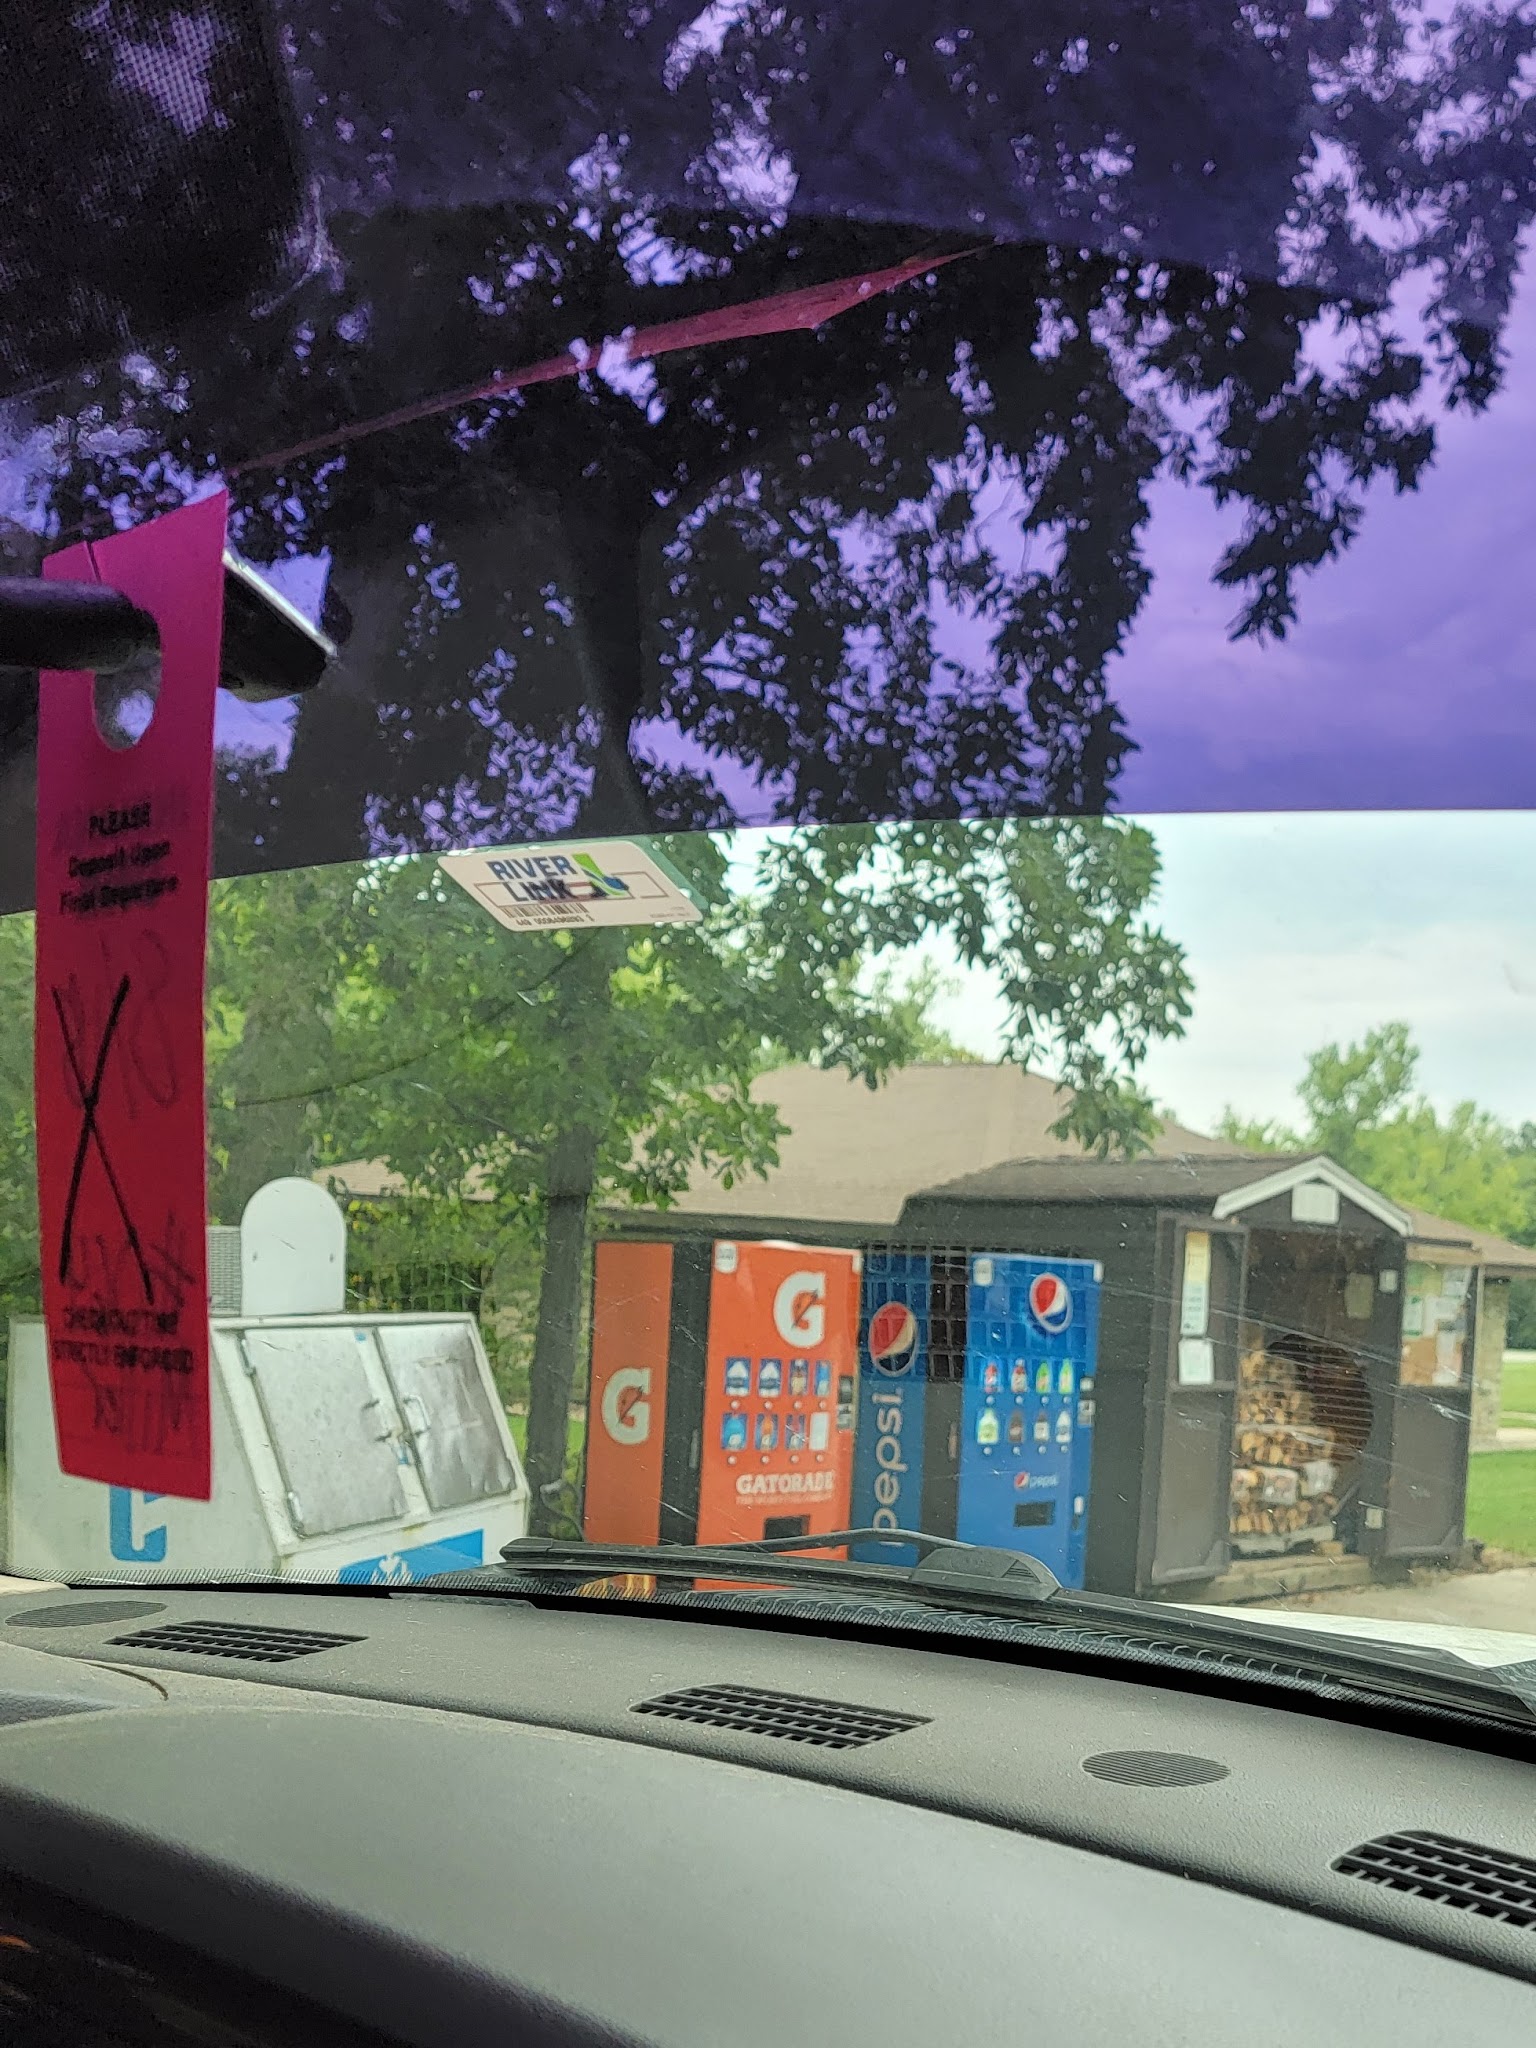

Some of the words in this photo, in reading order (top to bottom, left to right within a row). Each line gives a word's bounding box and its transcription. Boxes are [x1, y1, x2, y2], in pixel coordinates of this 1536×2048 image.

[485, 854, 578, 881] RIVER
[502, 878, 573, 902] LINK
[773, 1271, 827, 1348] G
[602, 1367, 653, 1445] G
[871, 1388, 909, 1547] pepsi
